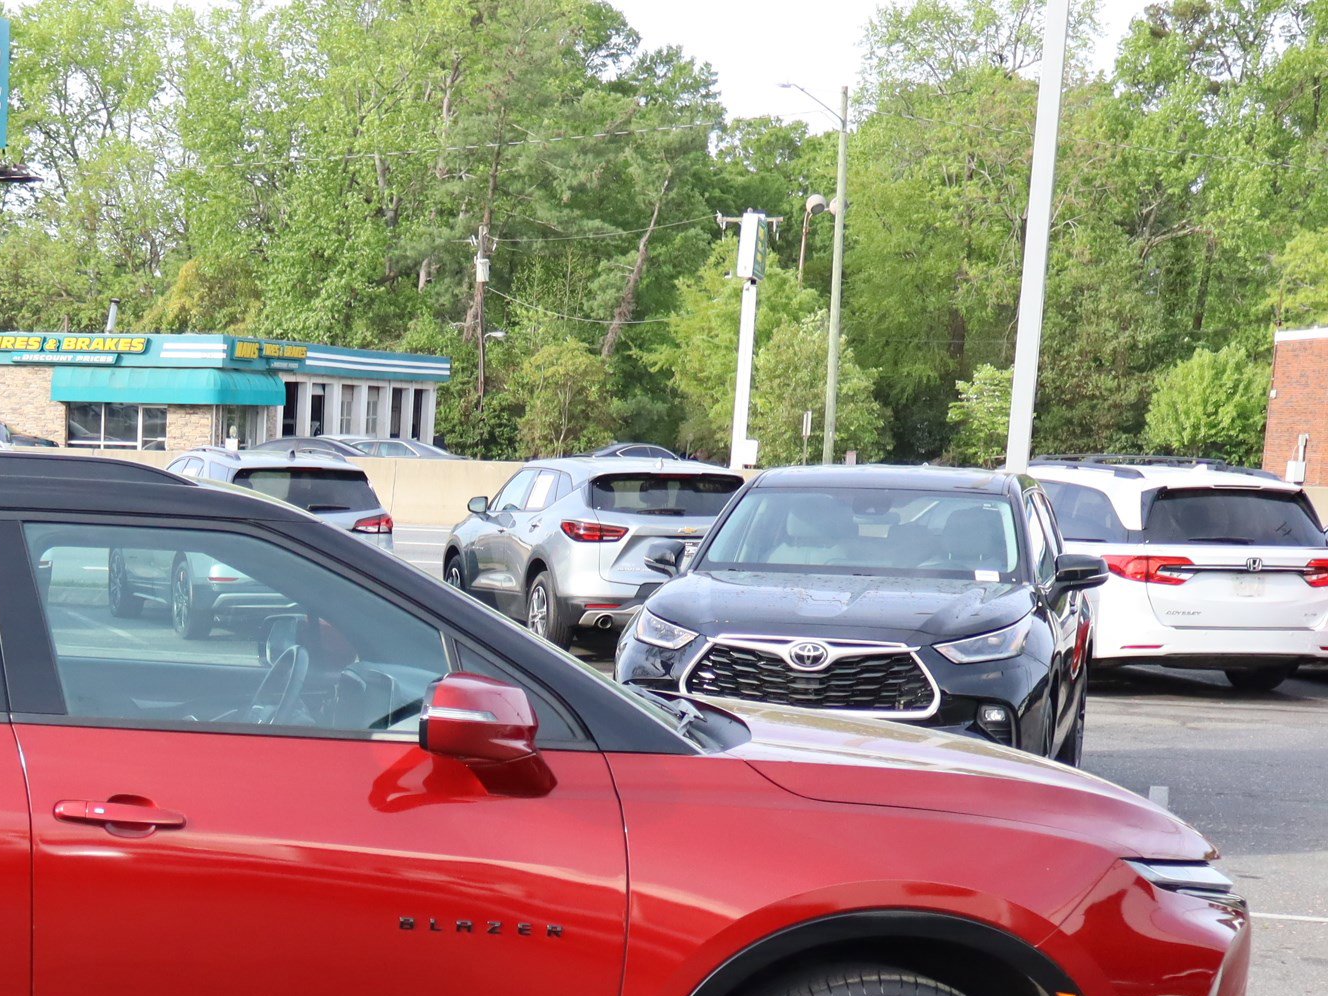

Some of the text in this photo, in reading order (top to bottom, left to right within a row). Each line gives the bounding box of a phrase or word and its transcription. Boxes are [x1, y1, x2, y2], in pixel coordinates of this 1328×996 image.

[44, 338, 59, 351] &
[61, 337, 147, 352] BRAKES
[22, 353, 74, 362] DISCOUNT
[76, 355, 114, 363] PRICES
[399, 916, 564, 938] BLAZER
